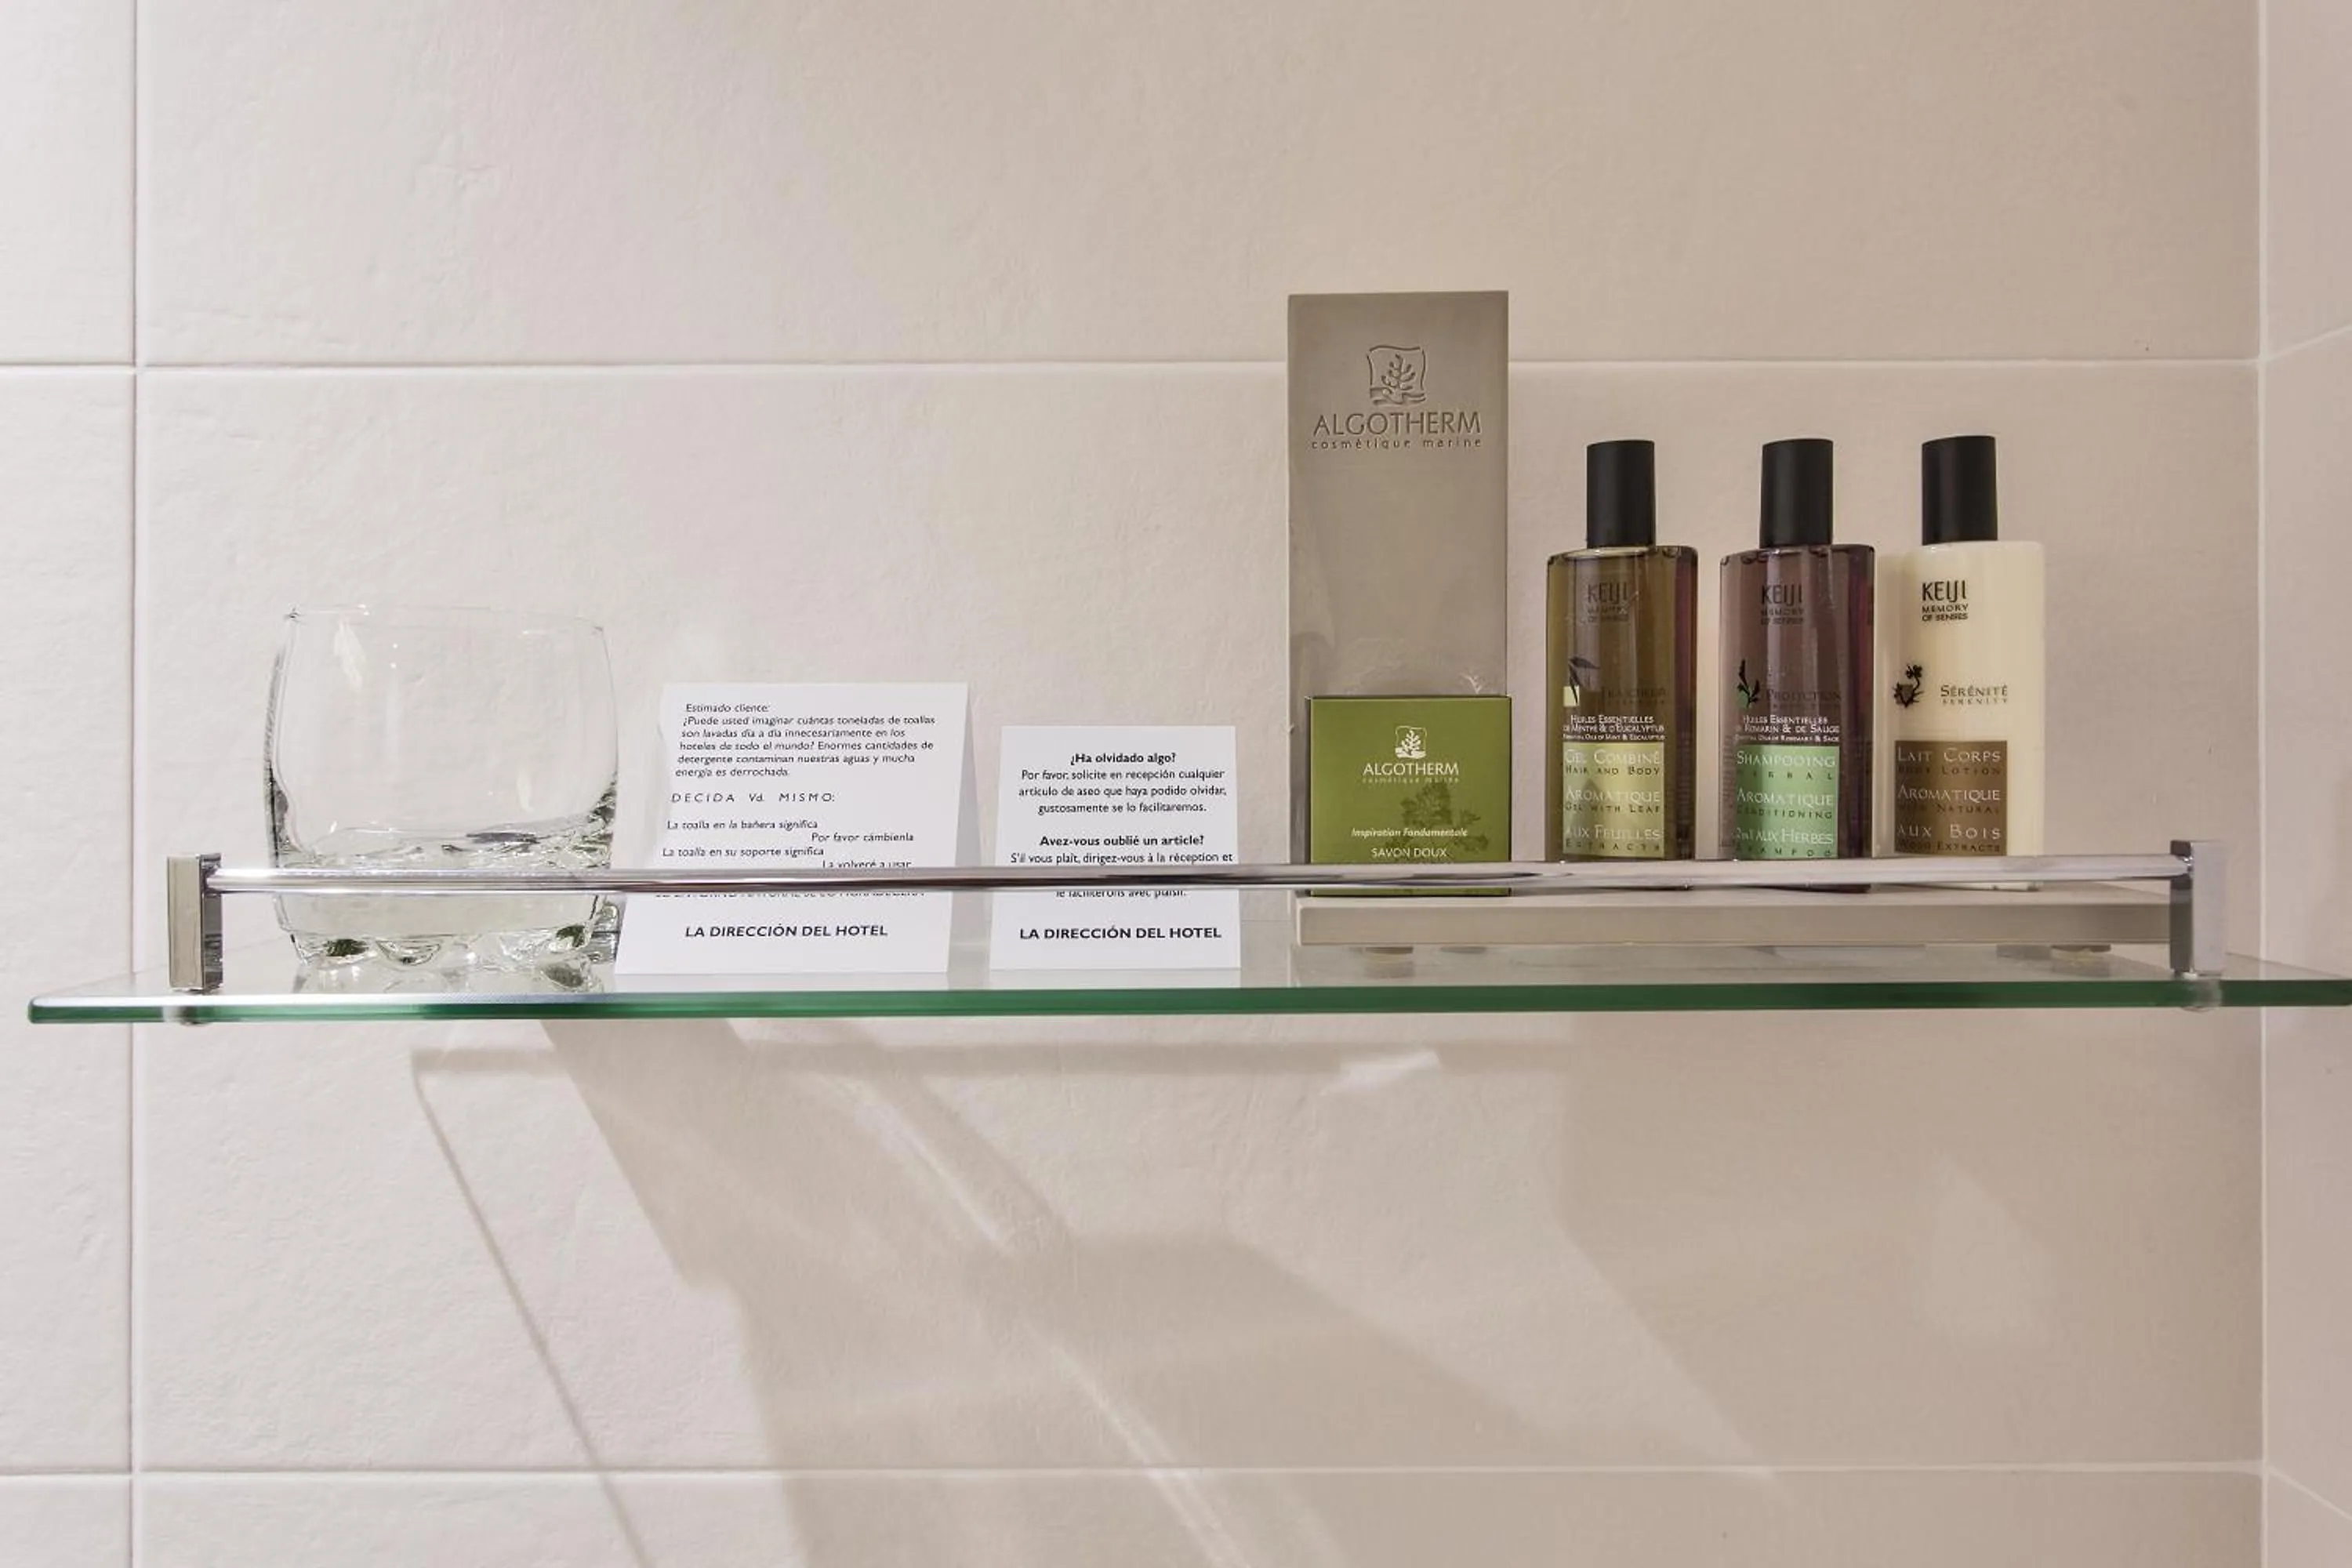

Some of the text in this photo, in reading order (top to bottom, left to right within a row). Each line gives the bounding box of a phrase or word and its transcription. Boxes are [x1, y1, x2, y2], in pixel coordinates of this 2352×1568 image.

[1313, 412, 1481, 436] ALGOTHERM
[1423, 438, 1481, 447] marine
[1922, 604, 1968, 613] MEMORY
[686, 704, 731, 713] Estimado
[722, 716, 749, 725] usted
[753, 716, 795, 728] imaginar
[838, 716, 884, 725] toneladas
[888, 716, 901, 724] de
[903, 715, 935, 724] toallas
[702, 729, 737, 738] lavadas
[891, 728, 905, 737] los
[680, 741, 933, 750] hoteles de todo el mundo? Enormes cantidades de
[677, 754, 915, 767] detergente contaminan nuestras aguas y mucha
[1071, 753, 1175, 765] ¿Ha olvidado algo?
[1898, 747, 2001, 762] LAIT CORPS
[1022, 770, 1038, 779] Por
[1072, 770, 1106, 779] solicite
[1126, 770, 1175, 782] recepción
[1178, 769, 1225, 782] cualquier
[1363, 763, 1459, 775] ALGOTHERM
[1061, 786, 1074, 796] de
[1104, 789, 1121, 798] que
[1126, 786, 1148, 797] haya
[1151, 786, 1186, 797] podido
[1566, 787, 1661, 805] AROMATIQUE
[1737, 789, 1833, 808] AROMATIQUE
[1897, 784, 2001, 804] AROMATIQUE
[1038, 804, 1109, 815] gustosamente
[1127, 803, 1136, 812] lo
[1139, 802, 1207, 812] facilitaremos.
[667, 821, 678, 829] La
[682, 821, 710, 829] toalla
[729, 821, 737, 829] la
[779, 819, 818, 832] significa
[1897, 824, 2001, 840] AUX BOIS
[811, 833, 830, 842] Por
[833, 833, 859, 842] favor
[1351, 828, 1401, 838] Inspiration
[1782, 828, 1832, 844] HERBES
[1040, 837, 1099, 846] Avez-vous
[1104, 836, 1138, 846] oublié
[1161, 835, 1203, 846] article?
[662, 848, 674, 857] La
[678, 848, 706, 857] toalla
[740, 848, 781, 858] soporte
[785, 846, 824, 858] significa
[1371, 848, 1447, 858] SAVON DOUX
[1029, 855, 1052, 863] vous
[1083, 852, 1144, 866] dirigez-vous
[1148, 852, 1153, 862] à
[1156, 852, 1165, 862] la
[1169, 852, 1218, 864] réception
[1222, 853, 1232, 862] et
[685, 923, 887, 938] LA DIRECCIÓN DEL HOTEL
[1020, 925, 1221, 939] LA DIRECCIÓN DEL HOTEL
